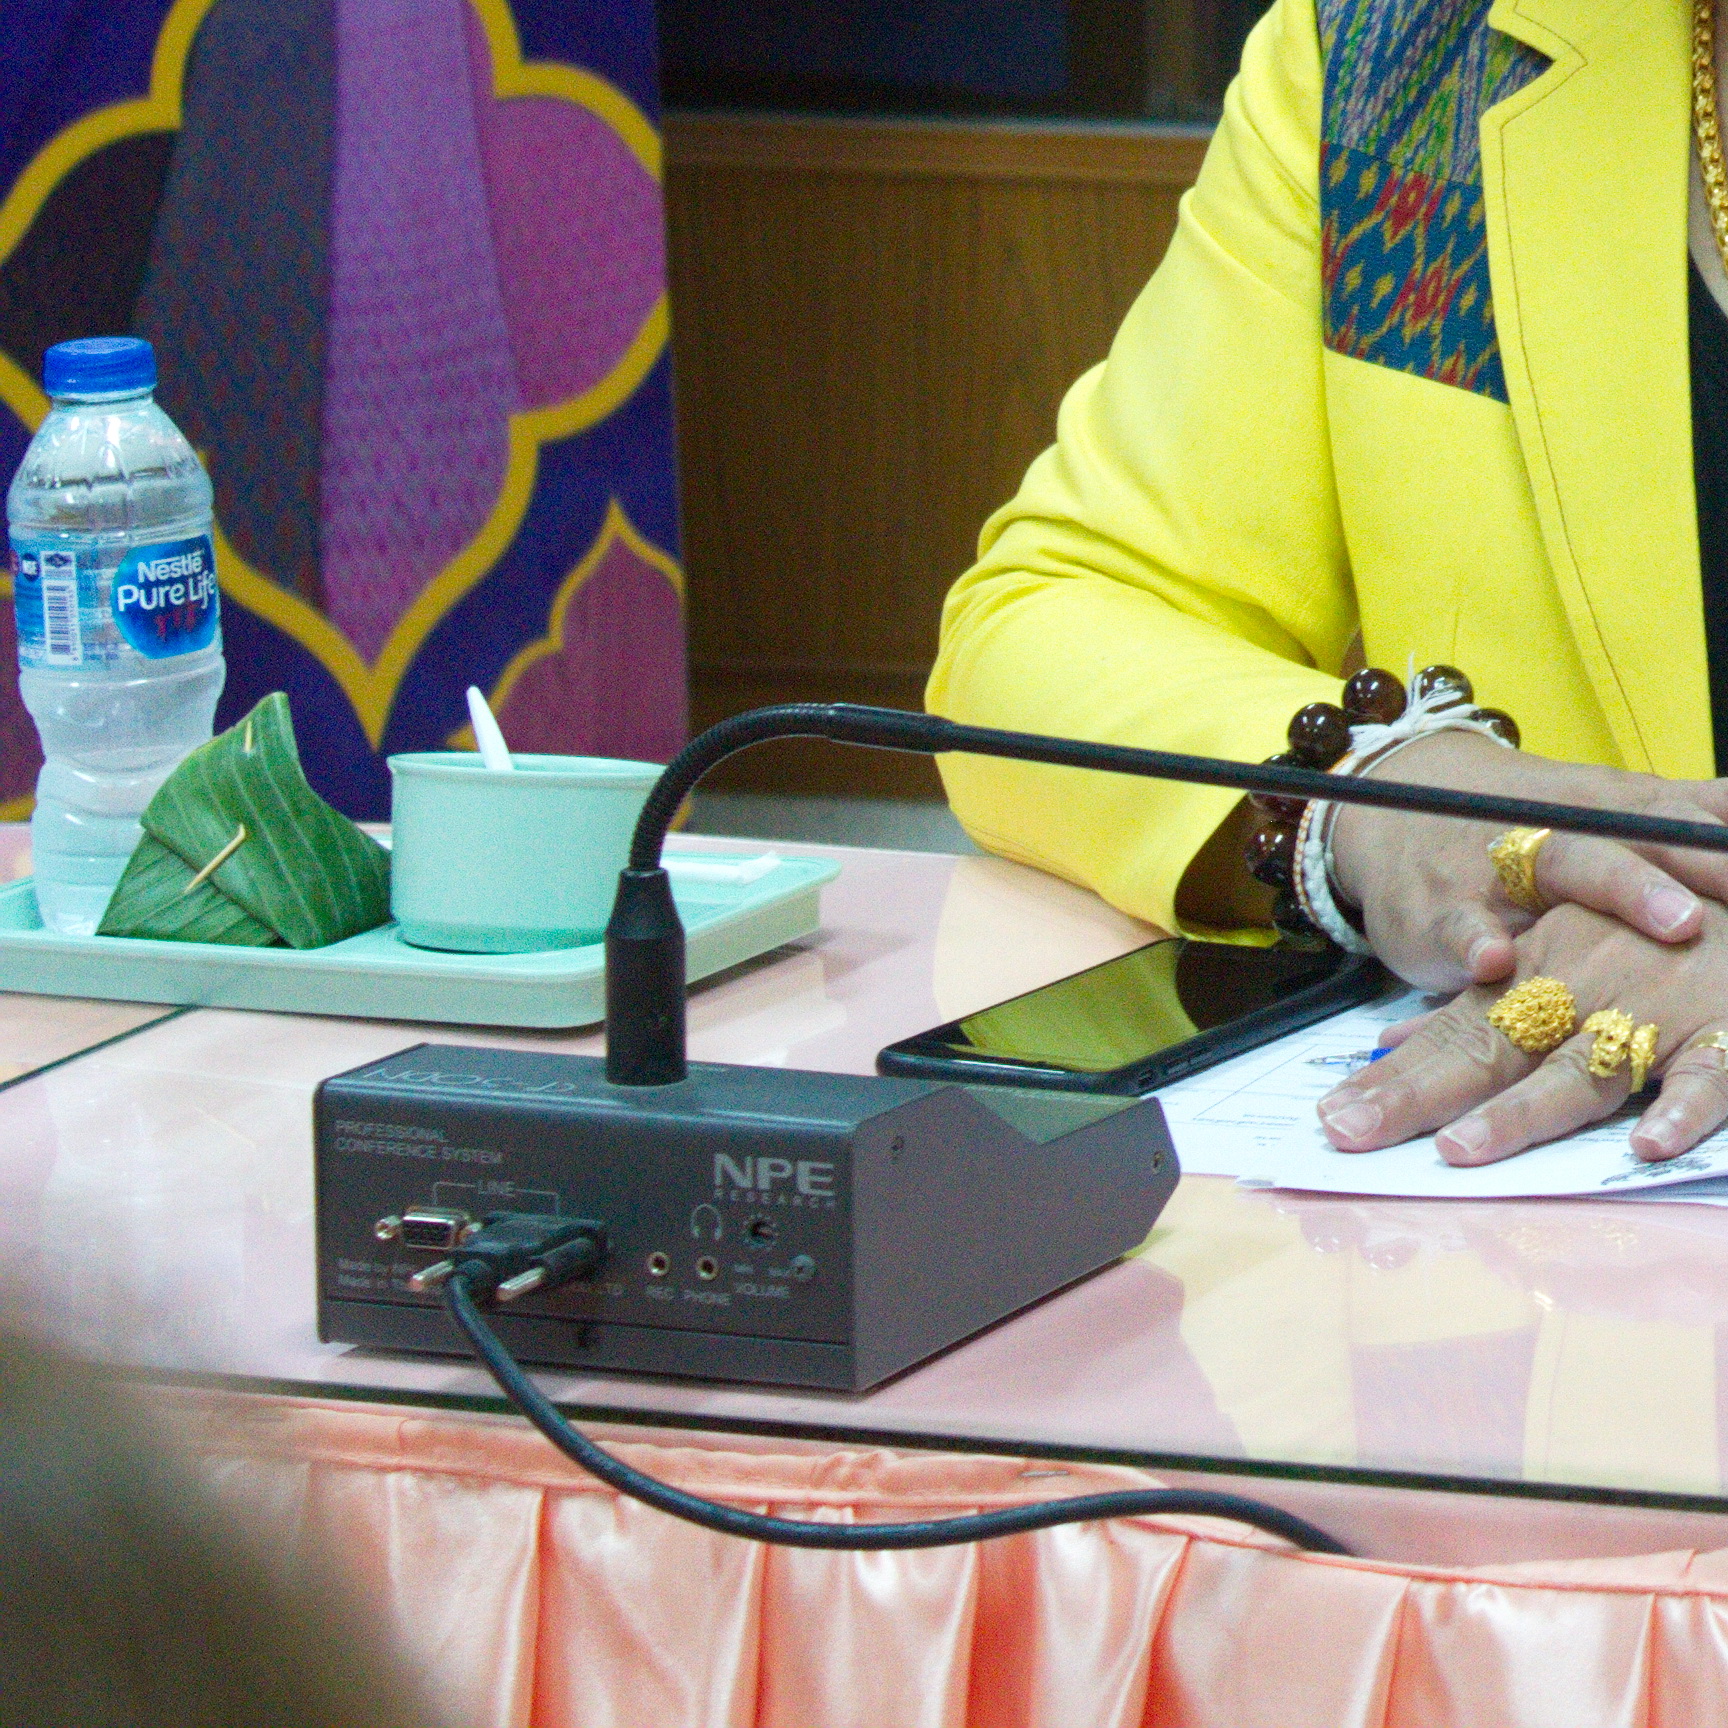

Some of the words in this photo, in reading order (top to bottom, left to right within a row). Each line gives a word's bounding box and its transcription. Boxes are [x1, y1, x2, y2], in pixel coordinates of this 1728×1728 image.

[117, 580, 185, 613] Pure
[188, 570, 216, 610] Life
[334, 1119, 448, 1143] PROFESSIONAL
[334, 1137, 438, 1161] CONFERENCE
[441, 1145, 504, 1165] SYSTEM
[713, 1152, 836, 1197] NPE
[475, 1180, 517, 1198] LINE
[713, 1188, 837, 1209] RESEARCH
[682, 1288, 731, 1307] PHONE
[734, 1282, 791, 1301] VOLUME
